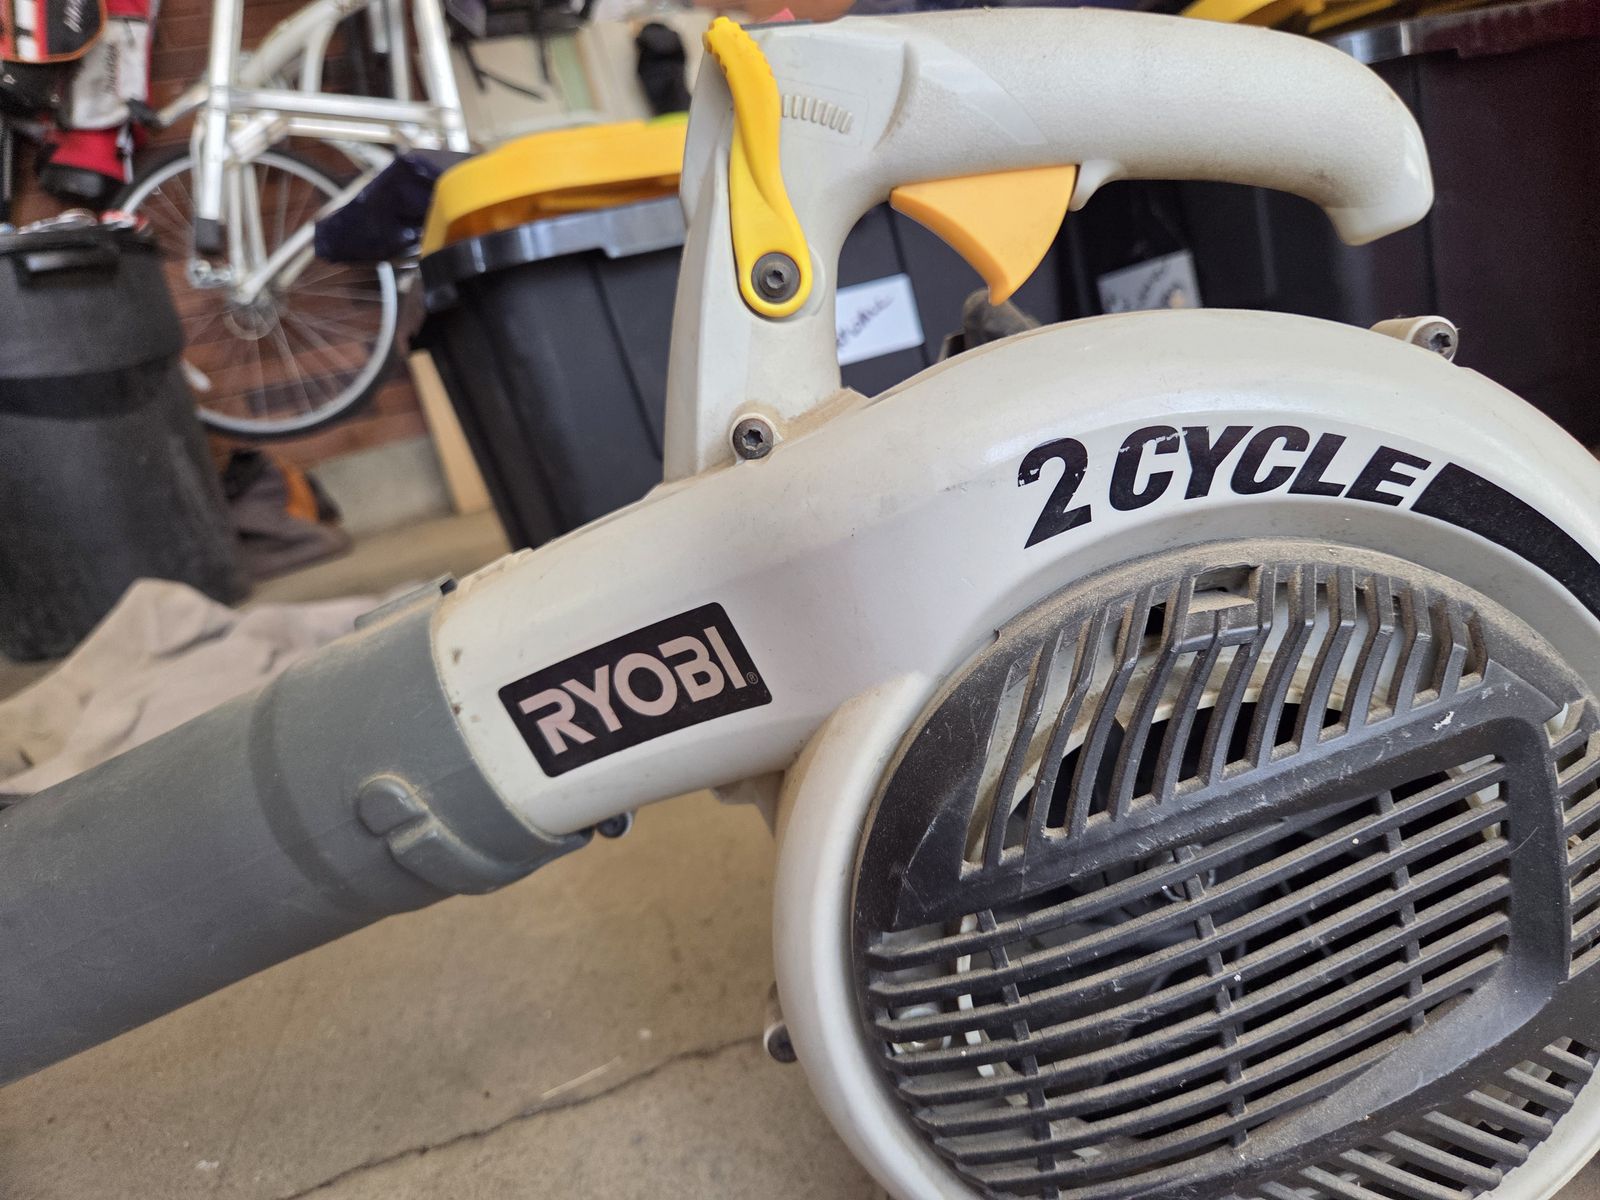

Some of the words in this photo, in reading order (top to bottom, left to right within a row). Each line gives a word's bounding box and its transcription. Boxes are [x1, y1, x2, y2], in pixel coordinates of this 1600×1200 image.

[1017, 437, 1092, 549] 2
[1108, 425, 1432, 508] CYCLE
[518, 626, 748, 756] RYOBI
